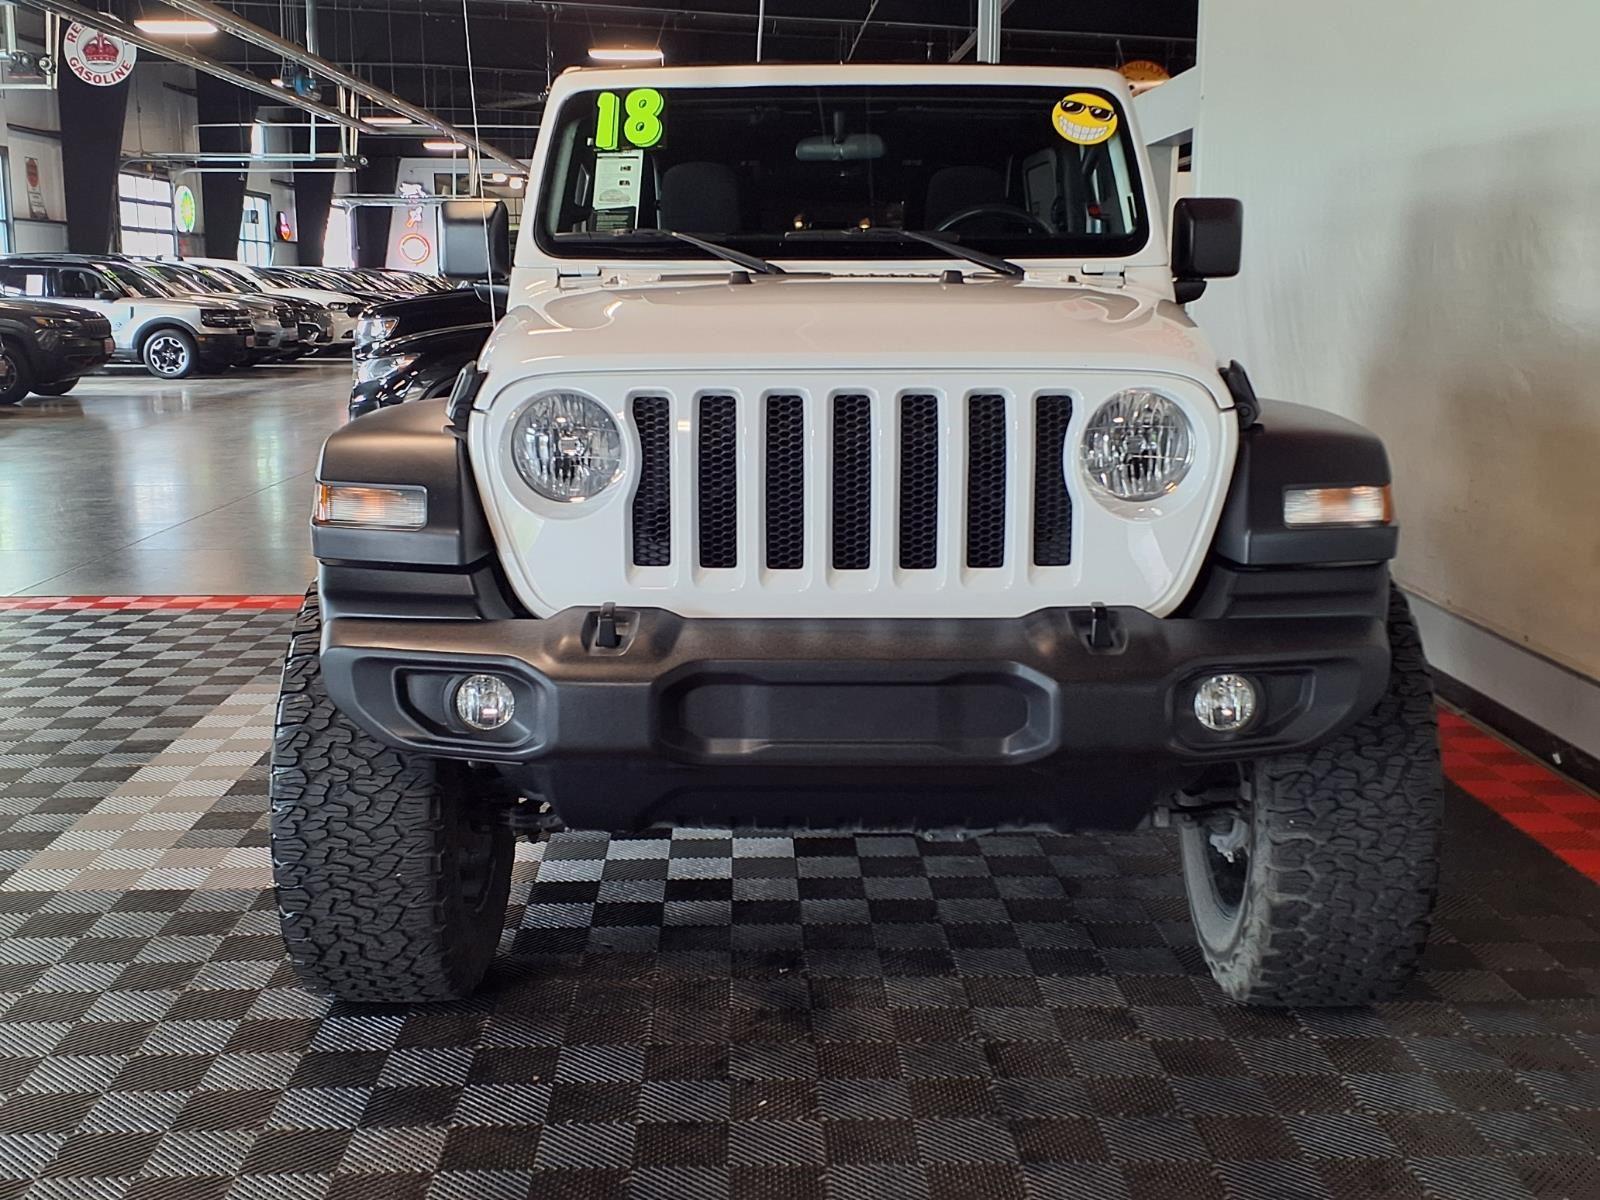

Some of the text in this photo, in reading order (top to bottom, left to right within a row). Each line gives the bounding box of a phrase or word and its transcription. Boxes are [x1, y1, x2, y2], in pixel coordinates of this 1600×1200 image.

[67, 23, 84, 43] RE
[69, 57, 132, 84] GASOLINE
[595, 88, 664, 150] 18
